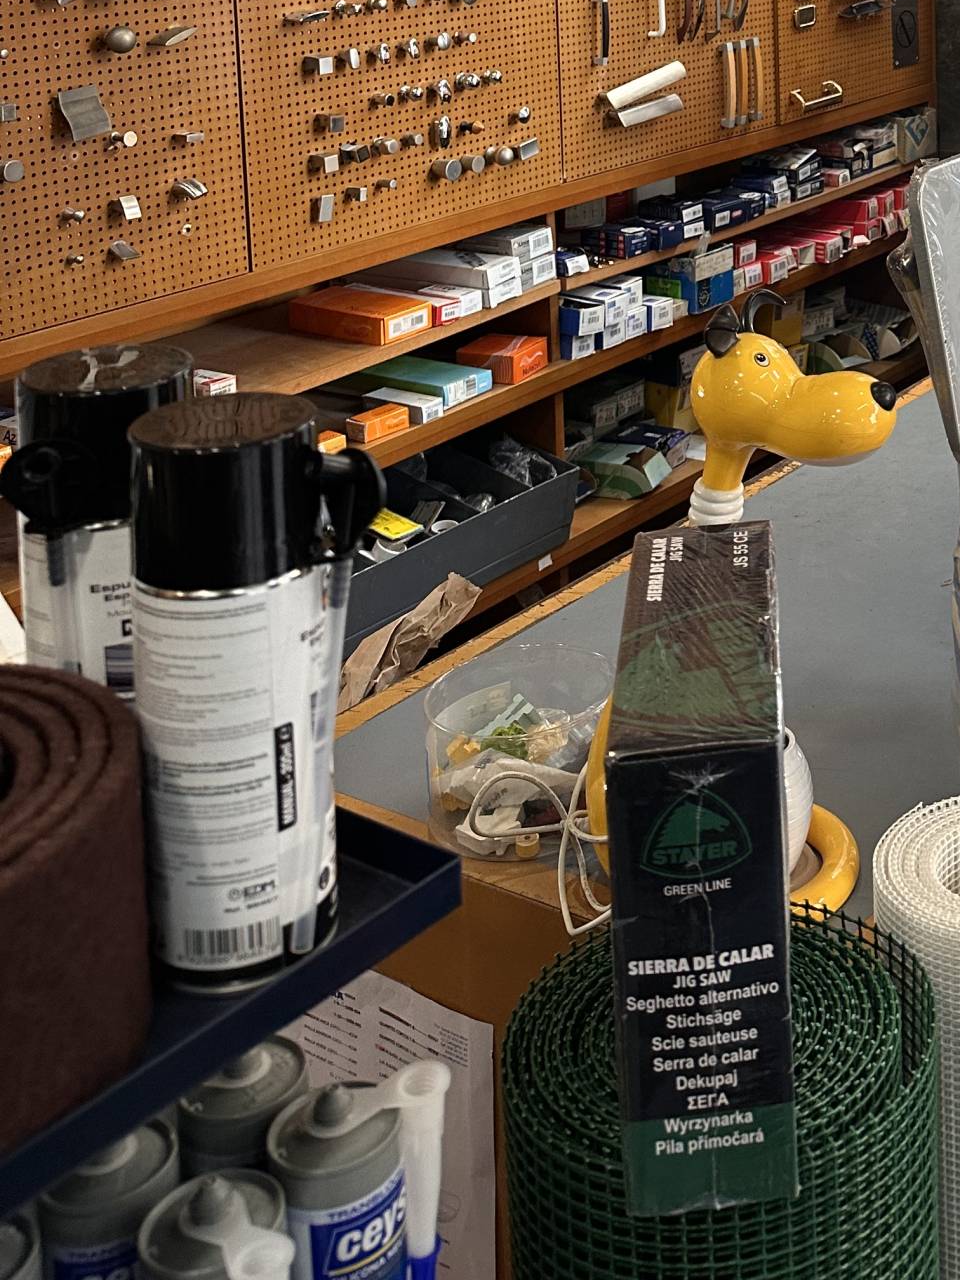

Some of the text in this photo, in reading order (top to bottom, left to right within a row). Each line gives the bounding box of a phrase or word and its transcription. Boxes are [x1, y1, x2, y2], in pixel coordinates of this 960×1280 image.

[669, 537, 684, 562] JIG SAW
[733, 530, 749, 568] JS 55 CE
[646, 538, 668, 601] SIERRA DE CALAR
[90, 581, 132, 594] Espu
[652, 840, 738, 865] STAYER
[664, 878, 732, 896] GREEN LINE
[628, 943, 774, 976] SIERRA DE CALAR
[673, 969, 732, 989] JIG SAW
[626, 980, 779, 1013] Seghetto alternativo
[666, 1009, 742, 1029] Stichsäge
[652, 1027, 758, 1051] Scie sauteuse
[653, 1047, 759, 1072] Serra de calar
[676, 1070, 738, 1091] Dekupaj
[664, 1110, 753, 1136] Wyrzynarka
[656, 1138, 684, 1155] Pila
